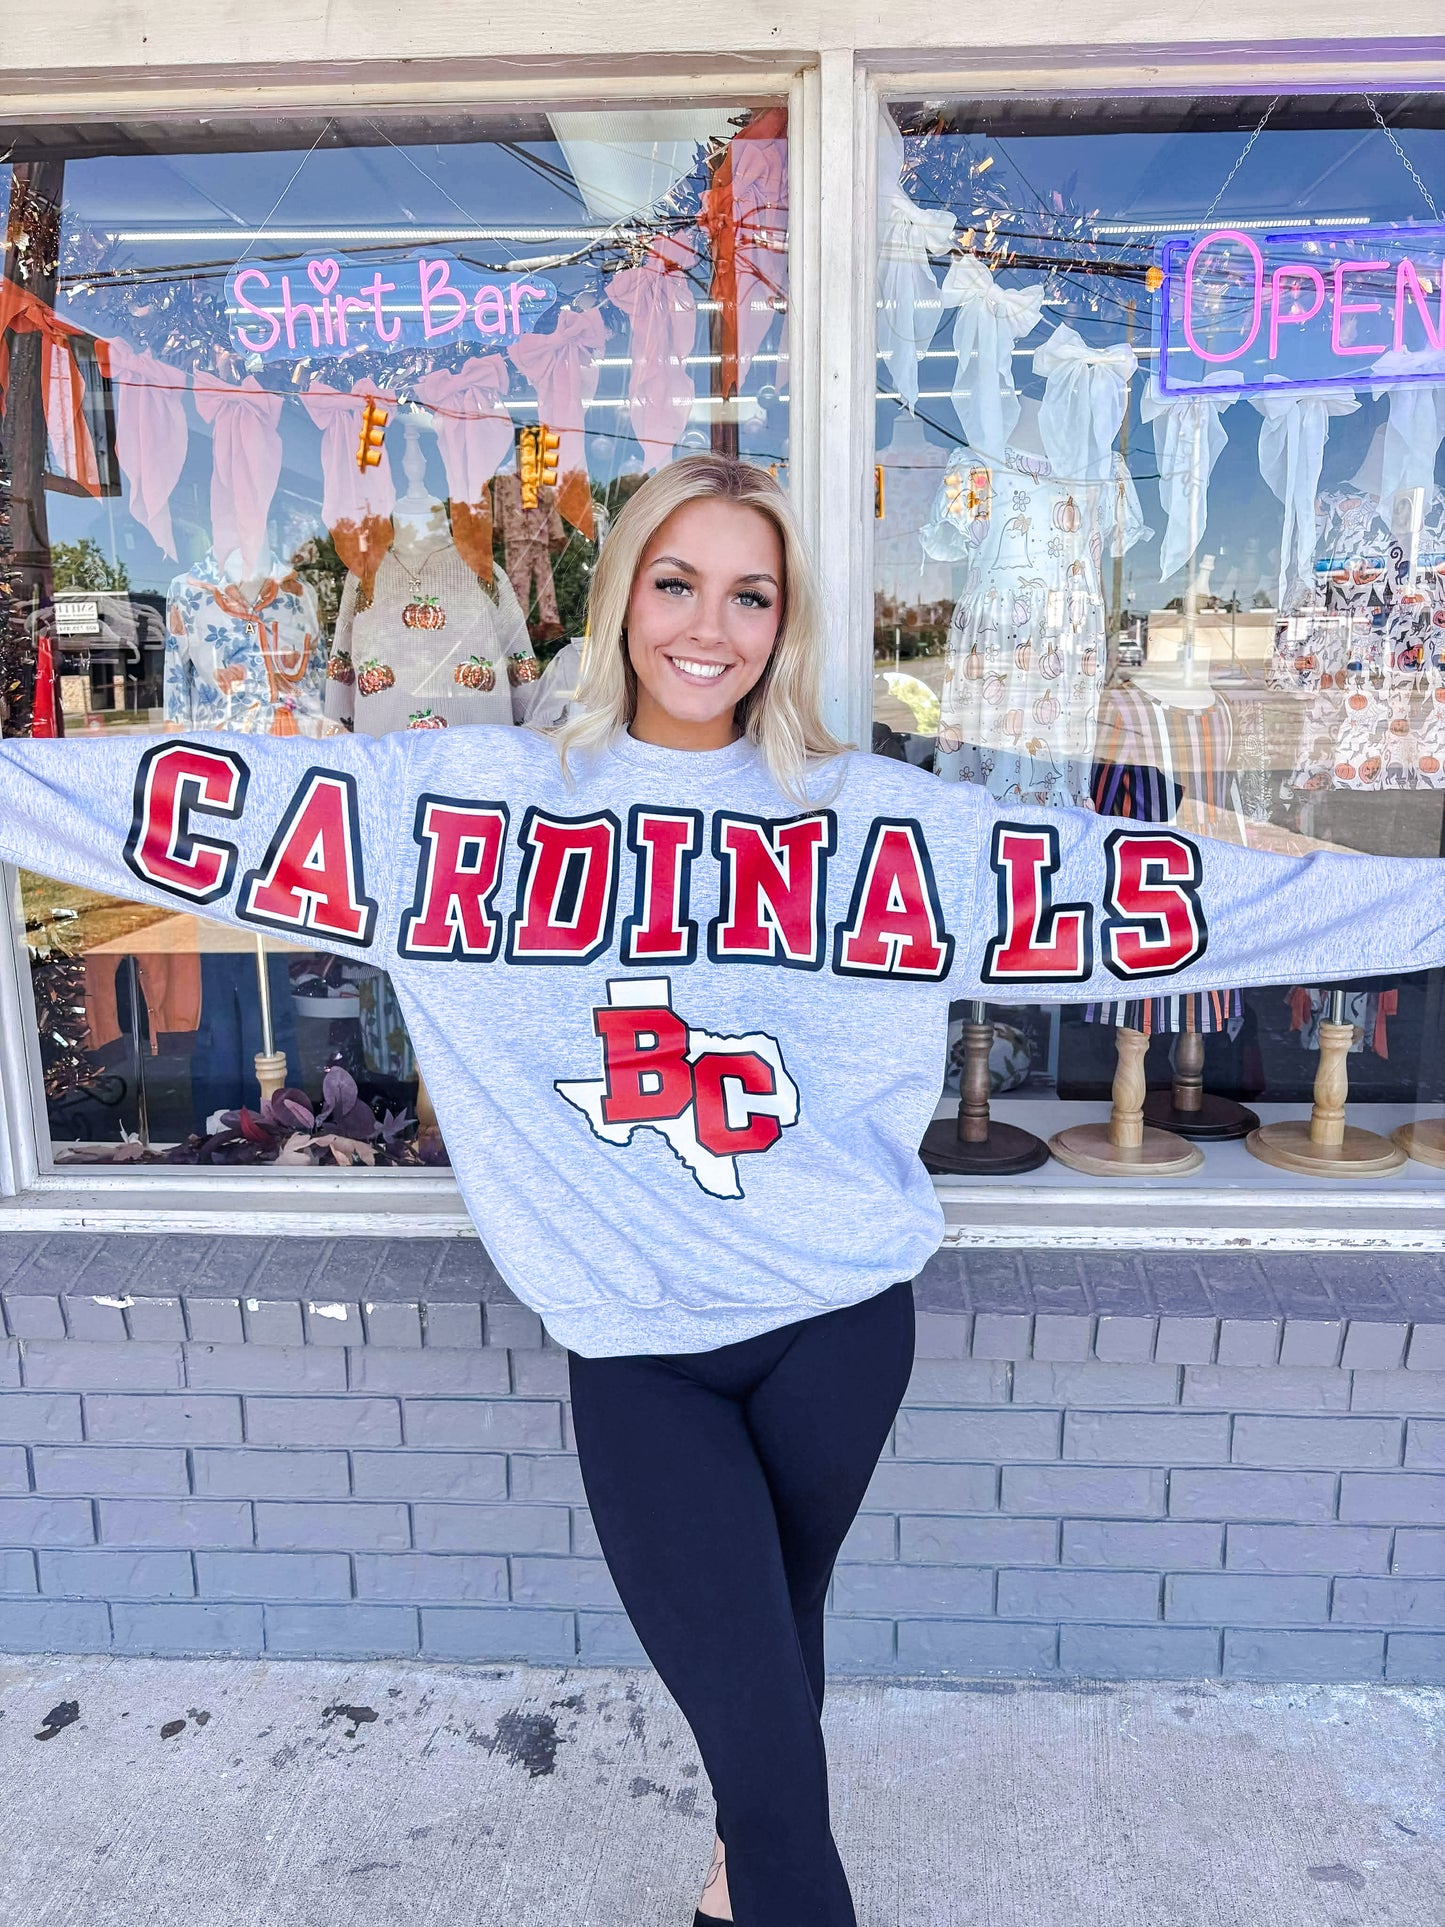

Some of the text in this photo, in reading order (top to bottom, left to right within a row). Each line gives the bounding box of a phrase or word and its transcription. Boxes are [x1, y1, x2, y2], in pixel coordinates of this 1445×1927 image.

[233, 258, 546, 351] Shirt Bar
[1183, 230, 1445, 363] OPEN
[123, 739, 1208, 984] CARDINALS
[592, 1004, 783, 1158] BC
